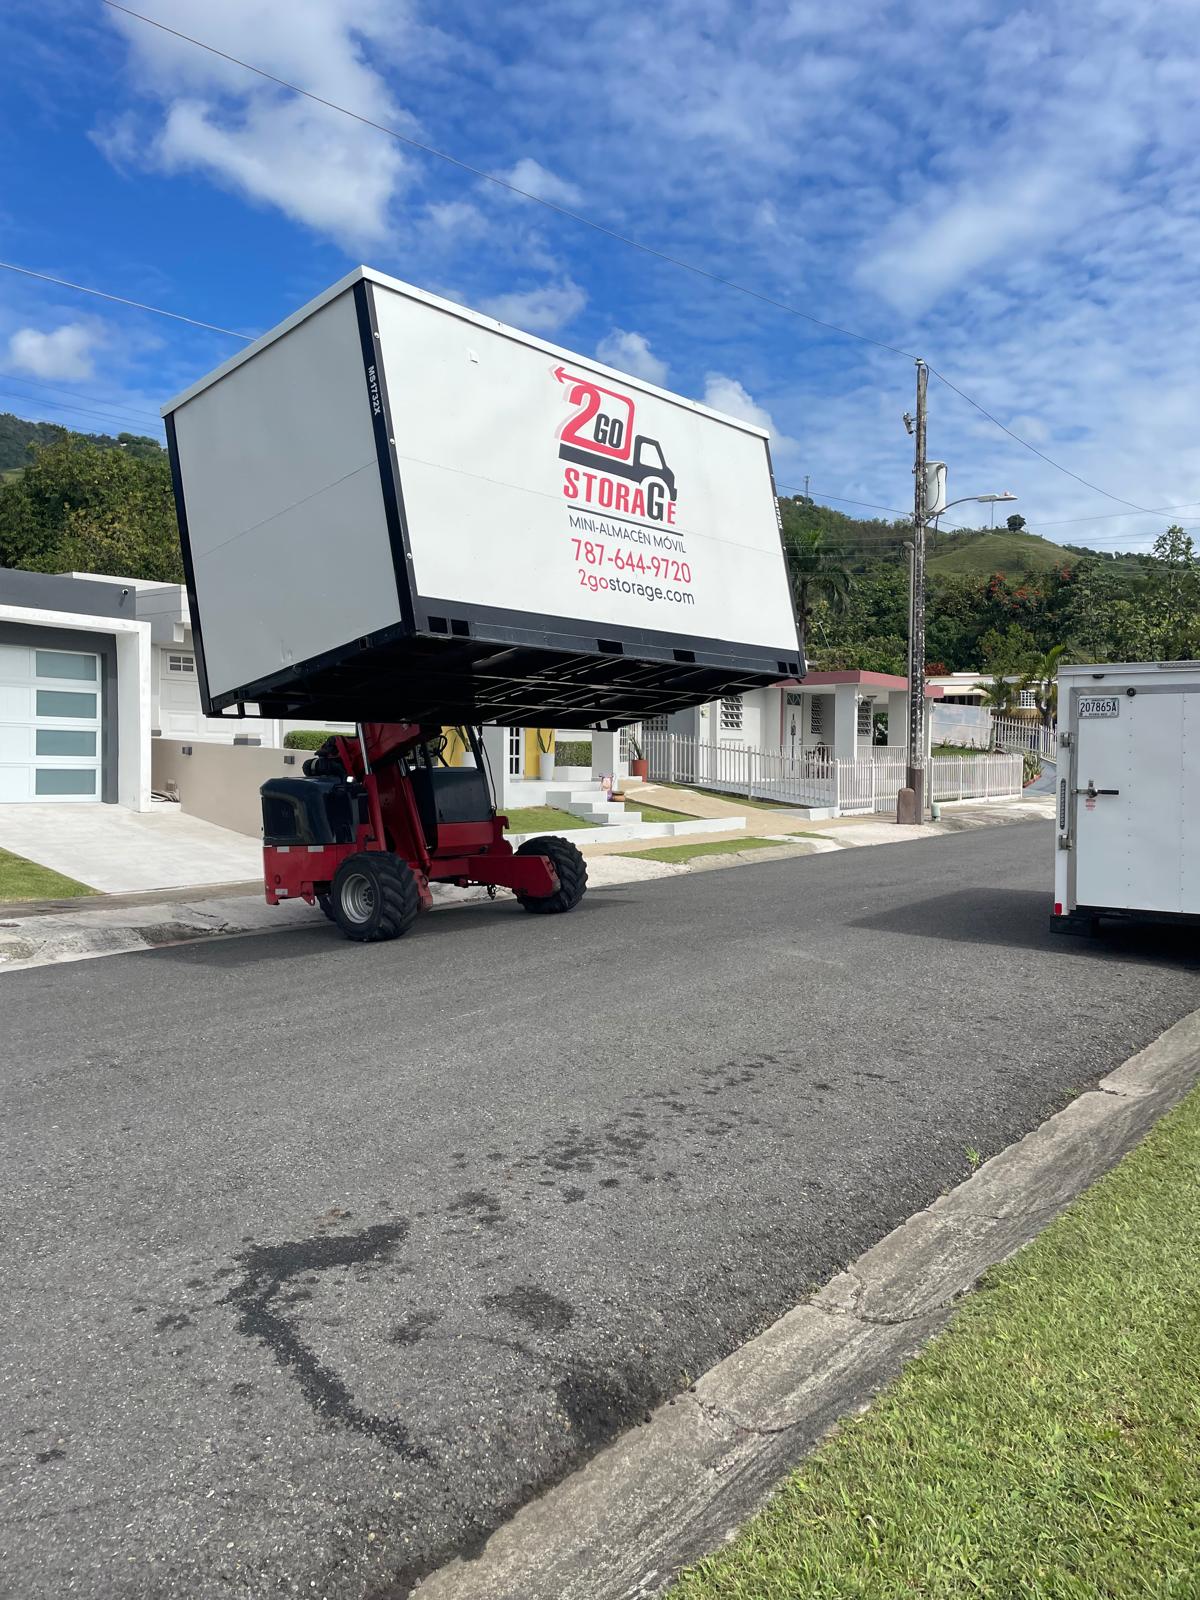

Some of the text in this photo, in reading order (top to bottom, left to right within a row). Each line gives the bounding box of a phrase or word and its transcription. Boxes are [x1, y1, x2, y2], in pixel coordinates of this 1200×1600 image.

[368, 365, 381, 416] MS1732X
[563, 467, 677, 525] STORAGE
[569, 514, 686, 553] MINI-ALMACÉN MÓVIL
[571, 538, 692, 584] 787-644-9720
[578, 568, 695, 605] 2gostorage.com
[1080, 701, 1117, 713] 207865A
